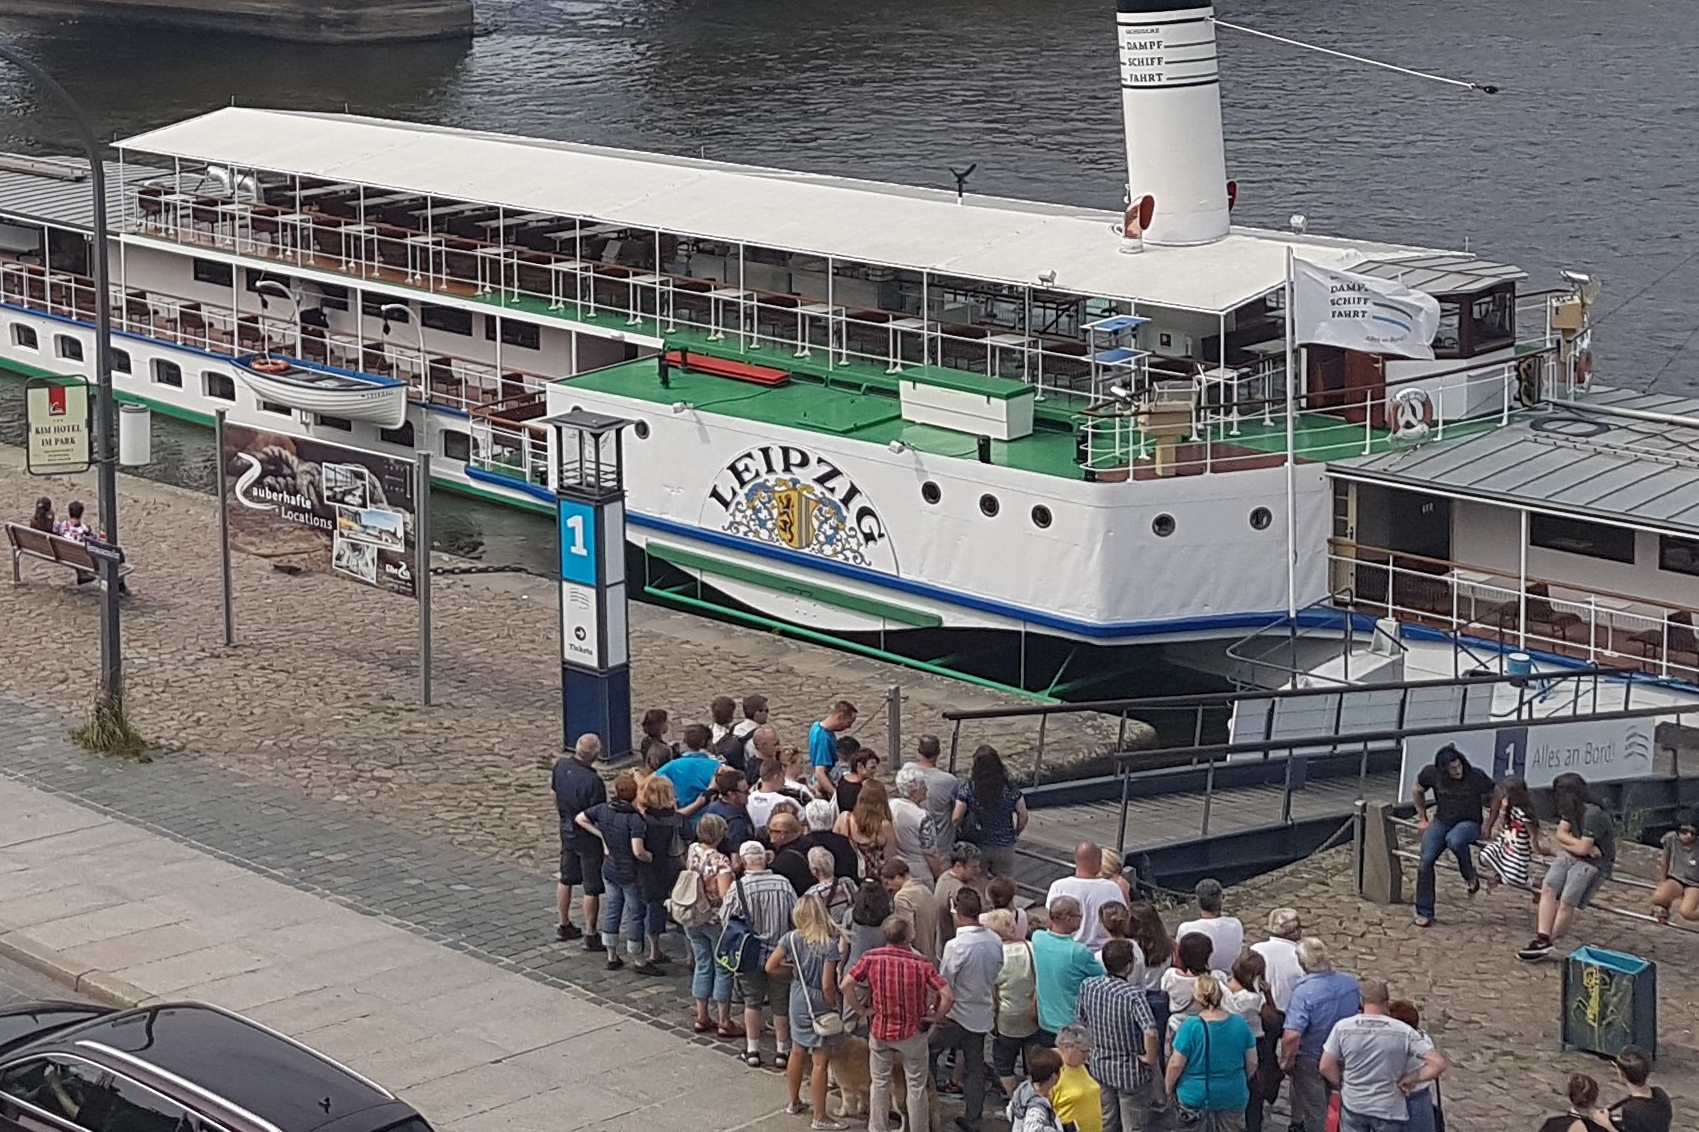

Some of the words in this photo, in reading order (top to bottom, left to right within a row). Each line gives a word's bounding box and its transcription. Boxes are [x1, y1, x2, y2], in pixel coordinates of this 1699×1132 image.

[1126, 40, 1163, 50] DAMPF
[1127, 56, 1164, 66] SCHIFF
[1129, 72, 1163, 82] FAHRT
[1330, 297, 1370, 306] SCHIFF
[1331, 309, 1368, 318] FAHRT
[35, 425, 51, 435] KIM
[53, 424, 82, 434] HOTEL
[41, 438, 52, 446] IM
[54, 436, 76, 445] PARK
[709, 445, 886, 546] LEIPZIG
[281, 506, 333, 530] Locations
[566, 514, 588, 557] 1
[1504, 742, 1516, 776] 1
[1531, 744, 1561, 769] Alles
[1564, 747, 1581, 766] an
[1584, 741, 1616, 765] Bord!
